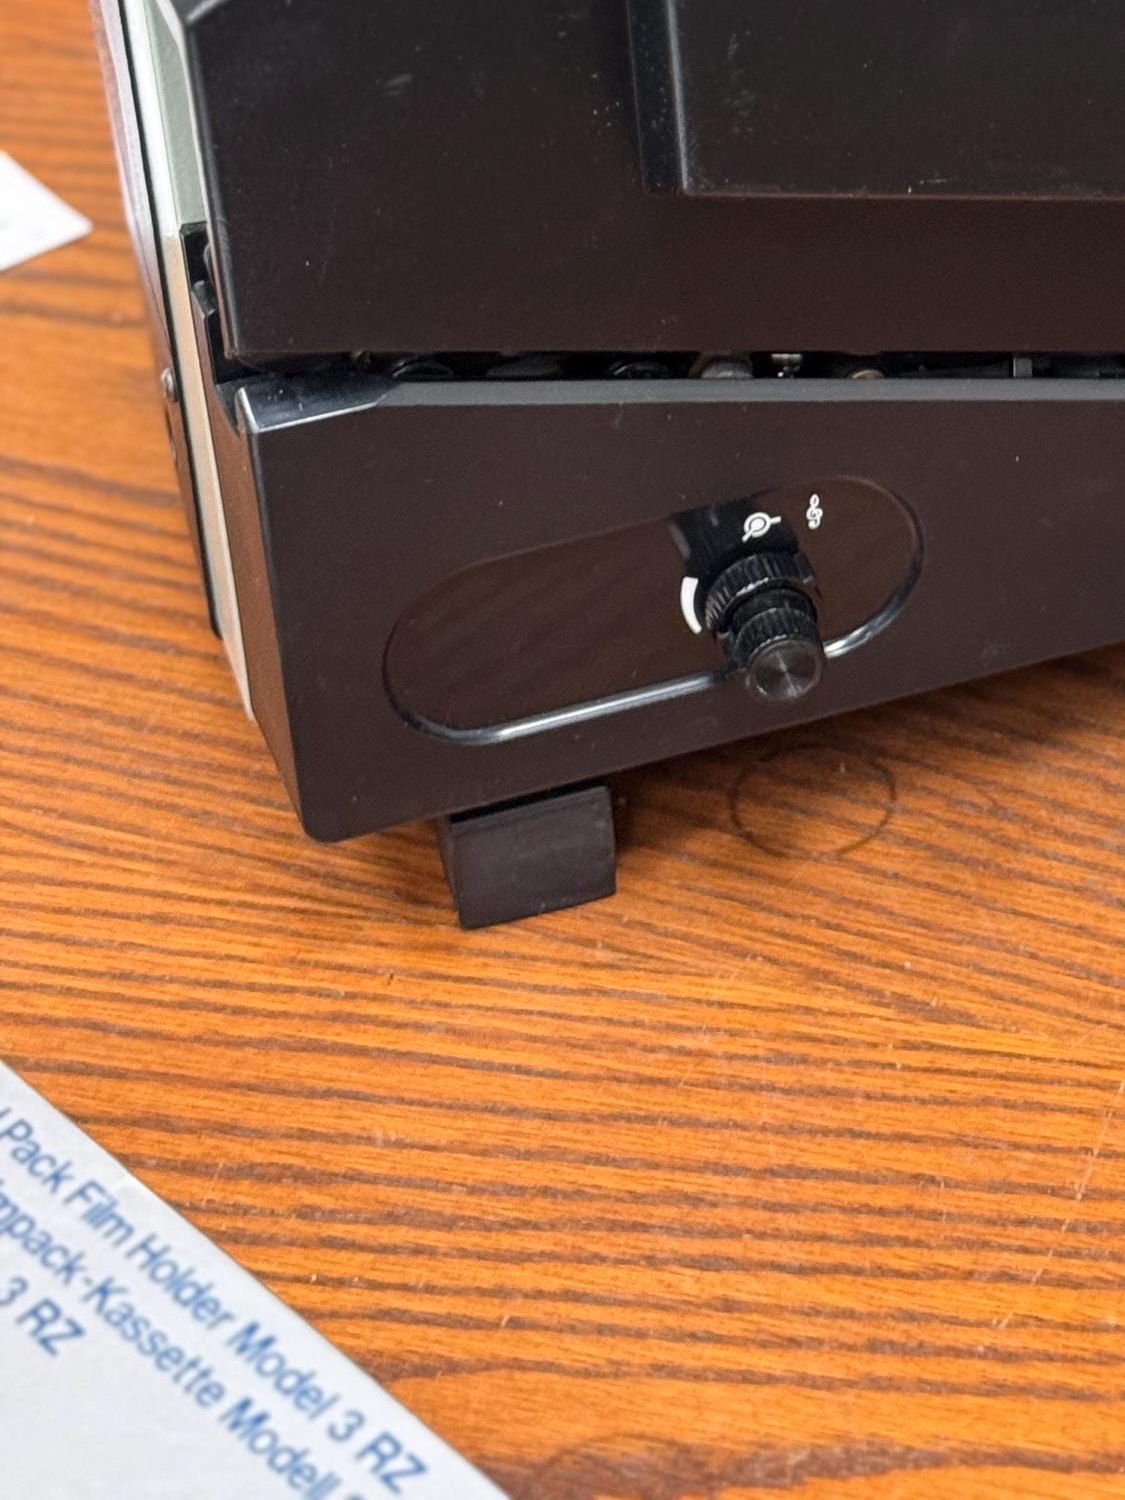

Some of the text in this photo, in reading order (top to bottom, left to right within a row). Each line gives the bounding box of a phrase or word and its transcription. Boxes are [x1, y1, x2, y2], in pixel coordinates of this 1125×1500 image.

[0, 1118, 429, 1495] Pack Film Holder Model 3 RZ
[15, 1298, 86, 1357] RZ
[218, 1397, 342, 1500] Modell
